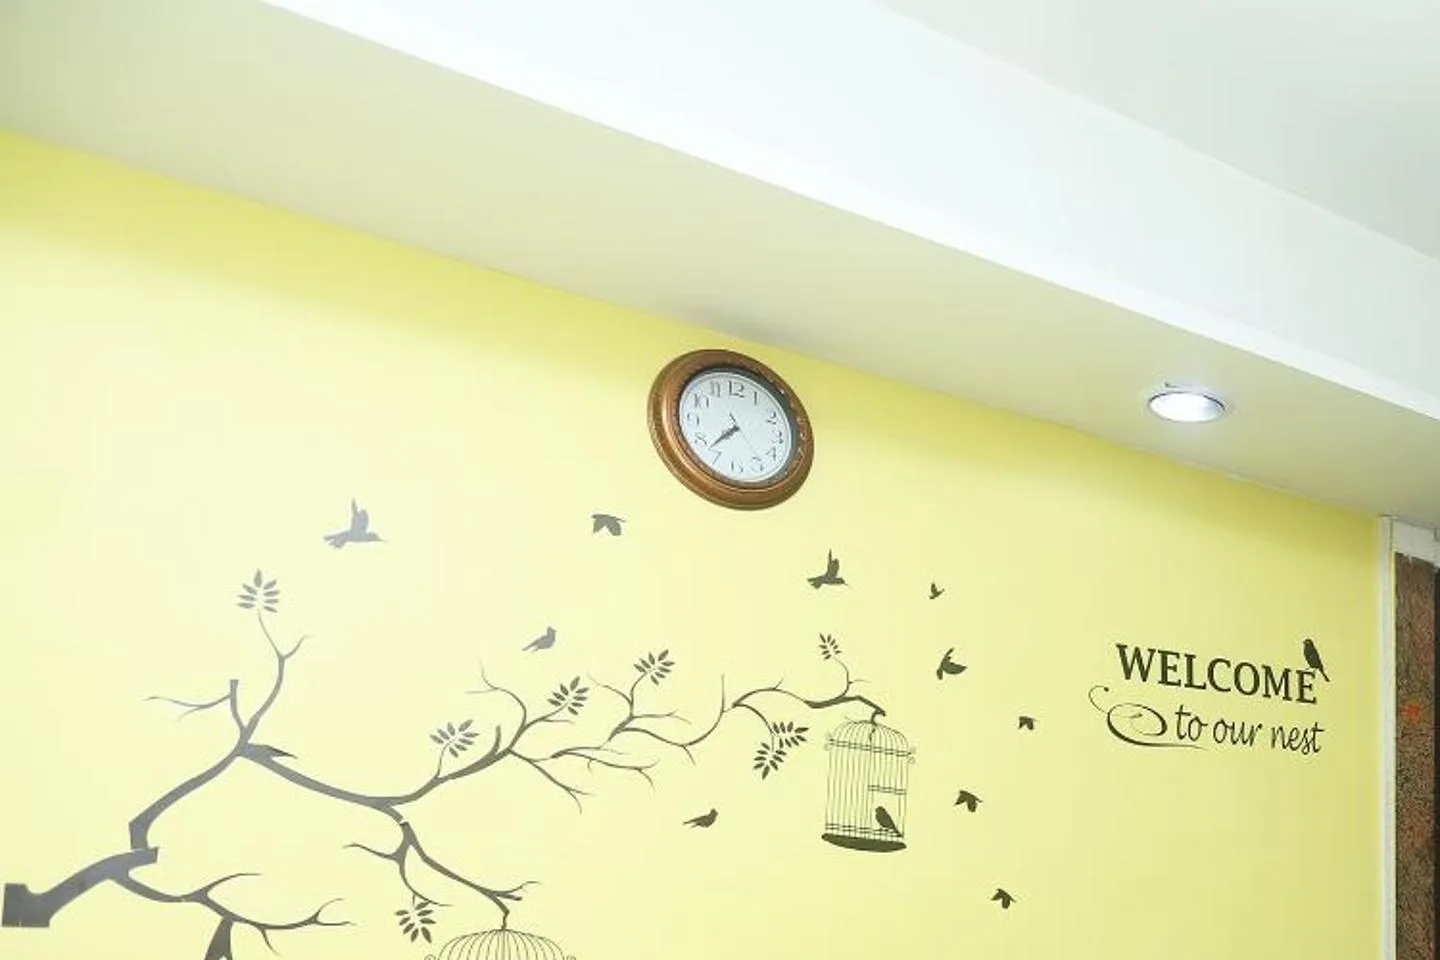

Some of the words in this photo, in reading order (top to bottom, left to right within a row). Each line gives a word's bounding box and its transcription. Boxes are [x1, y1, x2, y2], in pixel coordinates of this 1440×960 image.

[728, 380, 746, 398] 12
[766, 409, 777, 425] 2
[708, 448, 722, 465] 7
[765, 447, 777, 461] 4
[1116, 643, 1318, 704] WELCOME
[1175, 704, 1208, 741] to
[1212, 718, 1263, 747] our
[1270, 722, 1325, 755] nest
